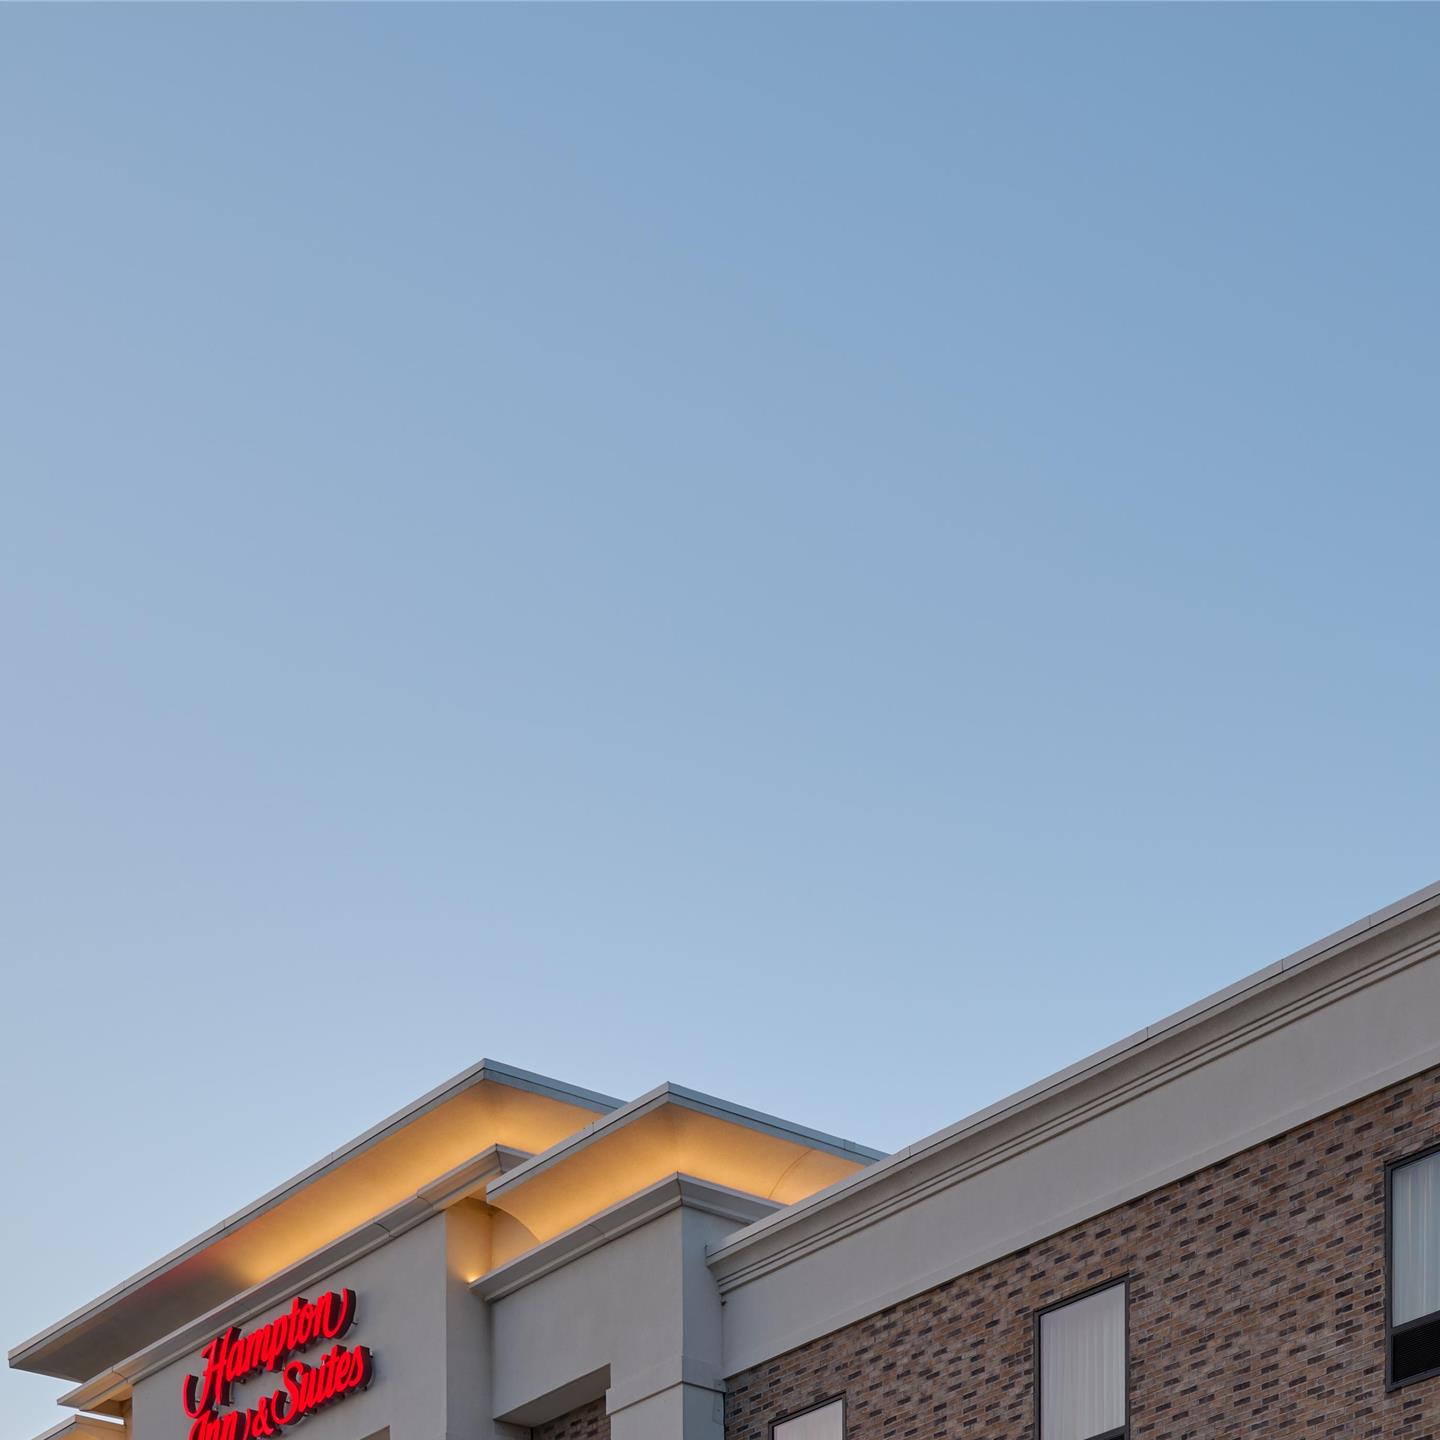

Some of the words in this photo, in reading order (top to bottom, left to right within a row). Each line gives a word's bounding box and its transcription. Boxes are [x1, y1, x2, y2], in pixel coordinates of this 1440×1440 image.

[182, 1287, 356, 1419] Hampton
[251, 1396, 276, 1438] &
[271, 1344, 368, 1425] Suites
